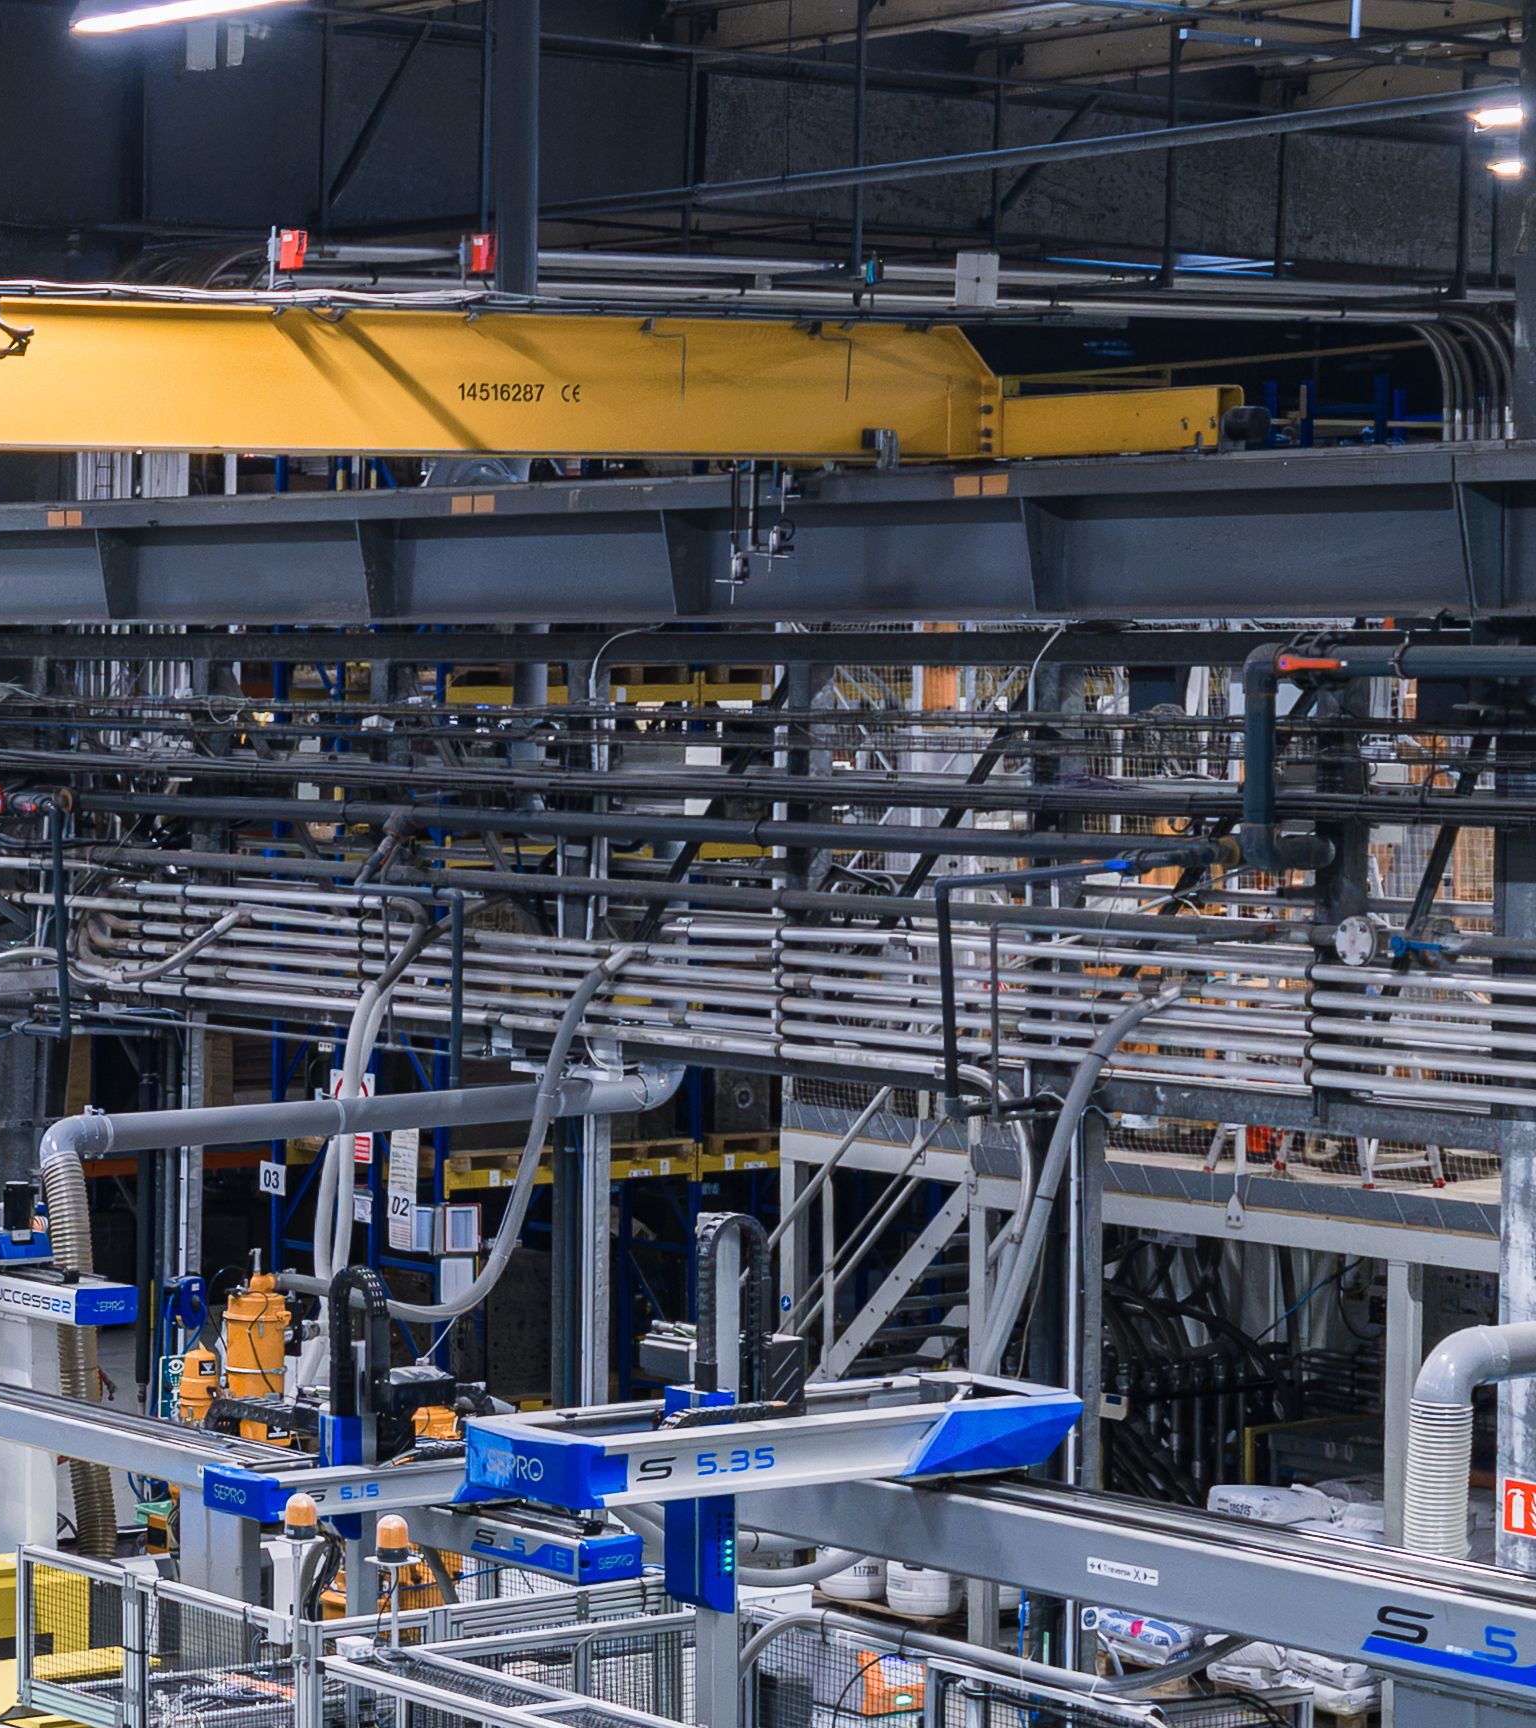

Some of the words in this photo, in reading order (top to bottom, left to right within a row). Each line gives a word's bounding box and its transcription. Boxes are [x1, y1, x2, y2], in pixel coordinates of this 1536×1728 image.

[458, 382, 545, 402] 14516287
[263, 1168, 280, 1189] 03
[391, 1195, 410, 1217] 02
[487, 1449, 544, 1482] SEPRO
[213, 1483, 247, 1505] SEPRO
[598, 1553, 634, 1570] SEPRO
